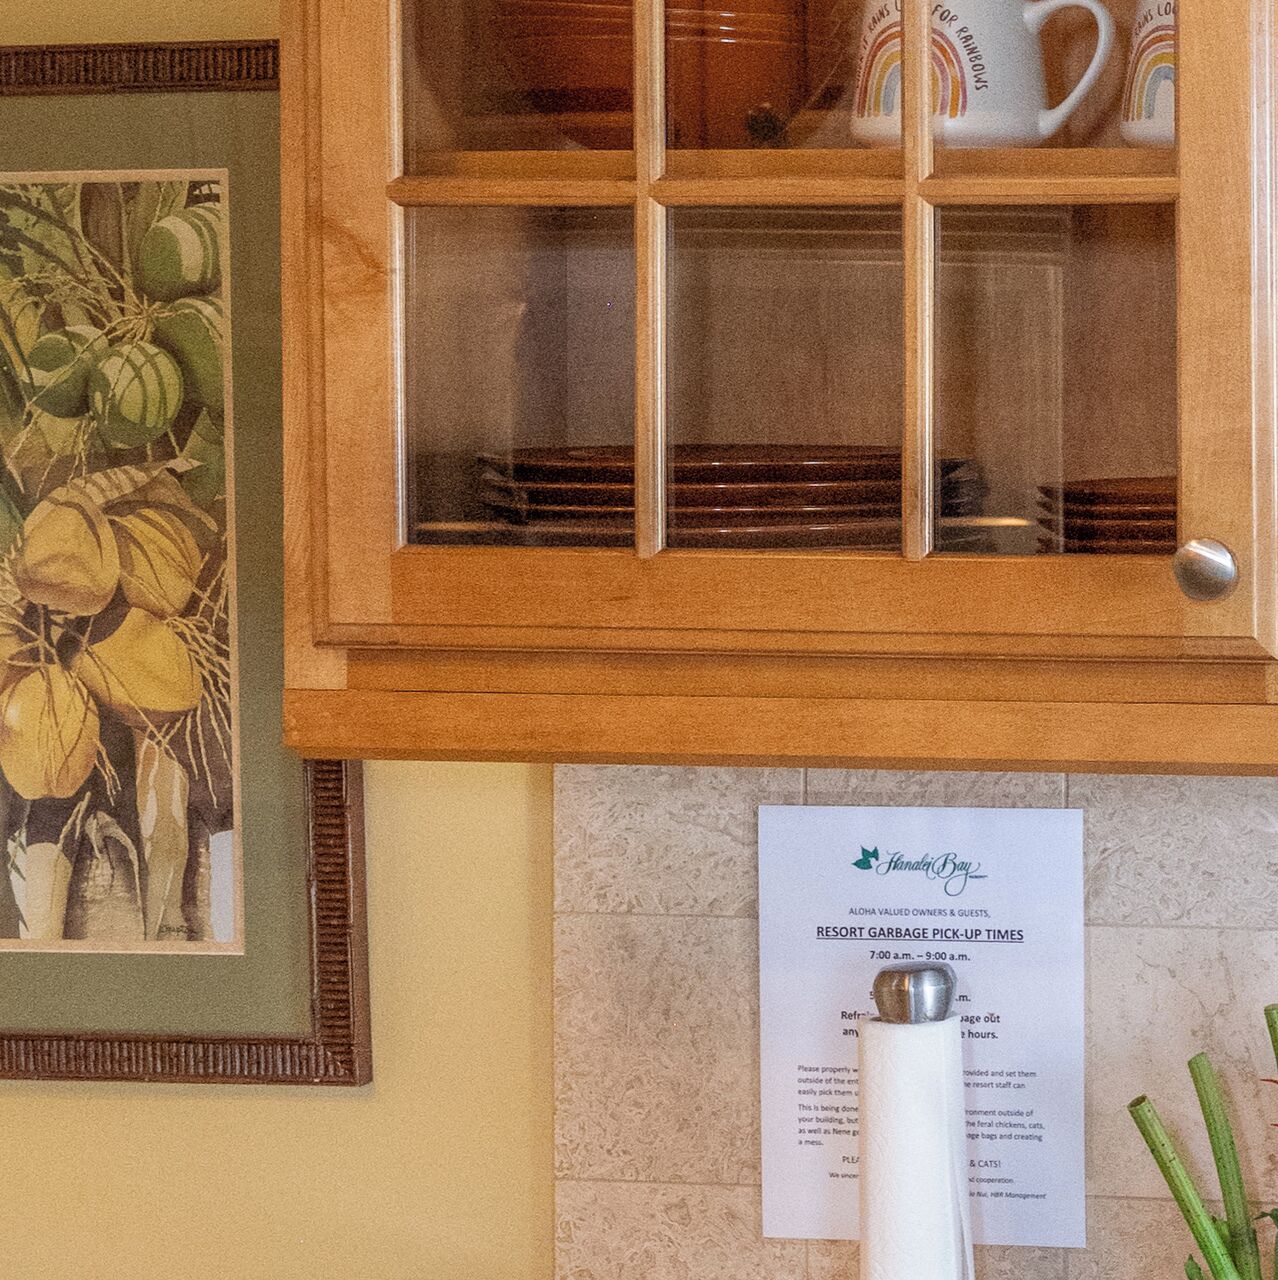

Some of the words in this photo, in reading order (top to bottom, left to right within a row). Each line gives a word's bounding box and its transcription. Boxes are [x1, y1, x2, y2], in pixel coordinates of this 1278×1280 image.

[931, 4, 959, 27] FOR
[876, 850, 935, 880] Hanalei
[932, 852, 981, 897] Bay
[849, 907, 876, 916] ALOHA
[878, 908, 910, 917] VALUED
[912, 908, 947, 917] OWNERS
[949, 909, 956, 917] &
[816, 926, 863, 938] RESORT
[868, 926, 929, 940] GARBAGE
[932, 928, 982, 940] PICK-UP
[985, 928, 1024, 941] TIMES
[869, 950, 891, 960] 7:00
[893, 952, 914, 961] a.m.
[925, 951, 947, 961] 9:00
[949, 953, 971, 962] a.m.
[984, 1015, 1000, 1023] out
[968, 1029, 998, 1039] hours.
[798, 1065, 819, 1073] Please
[963, 1070, 989, 1078] rovided
[991, 1070, 1004, 1078] and
[834, 1077, 845, 1085] the
[819, 1088, 833, 1096] pick
[798, 1104, 812, 1112] This
[821, 1104, 840, 1113] being
[969, 1160, 976, 1168] &
